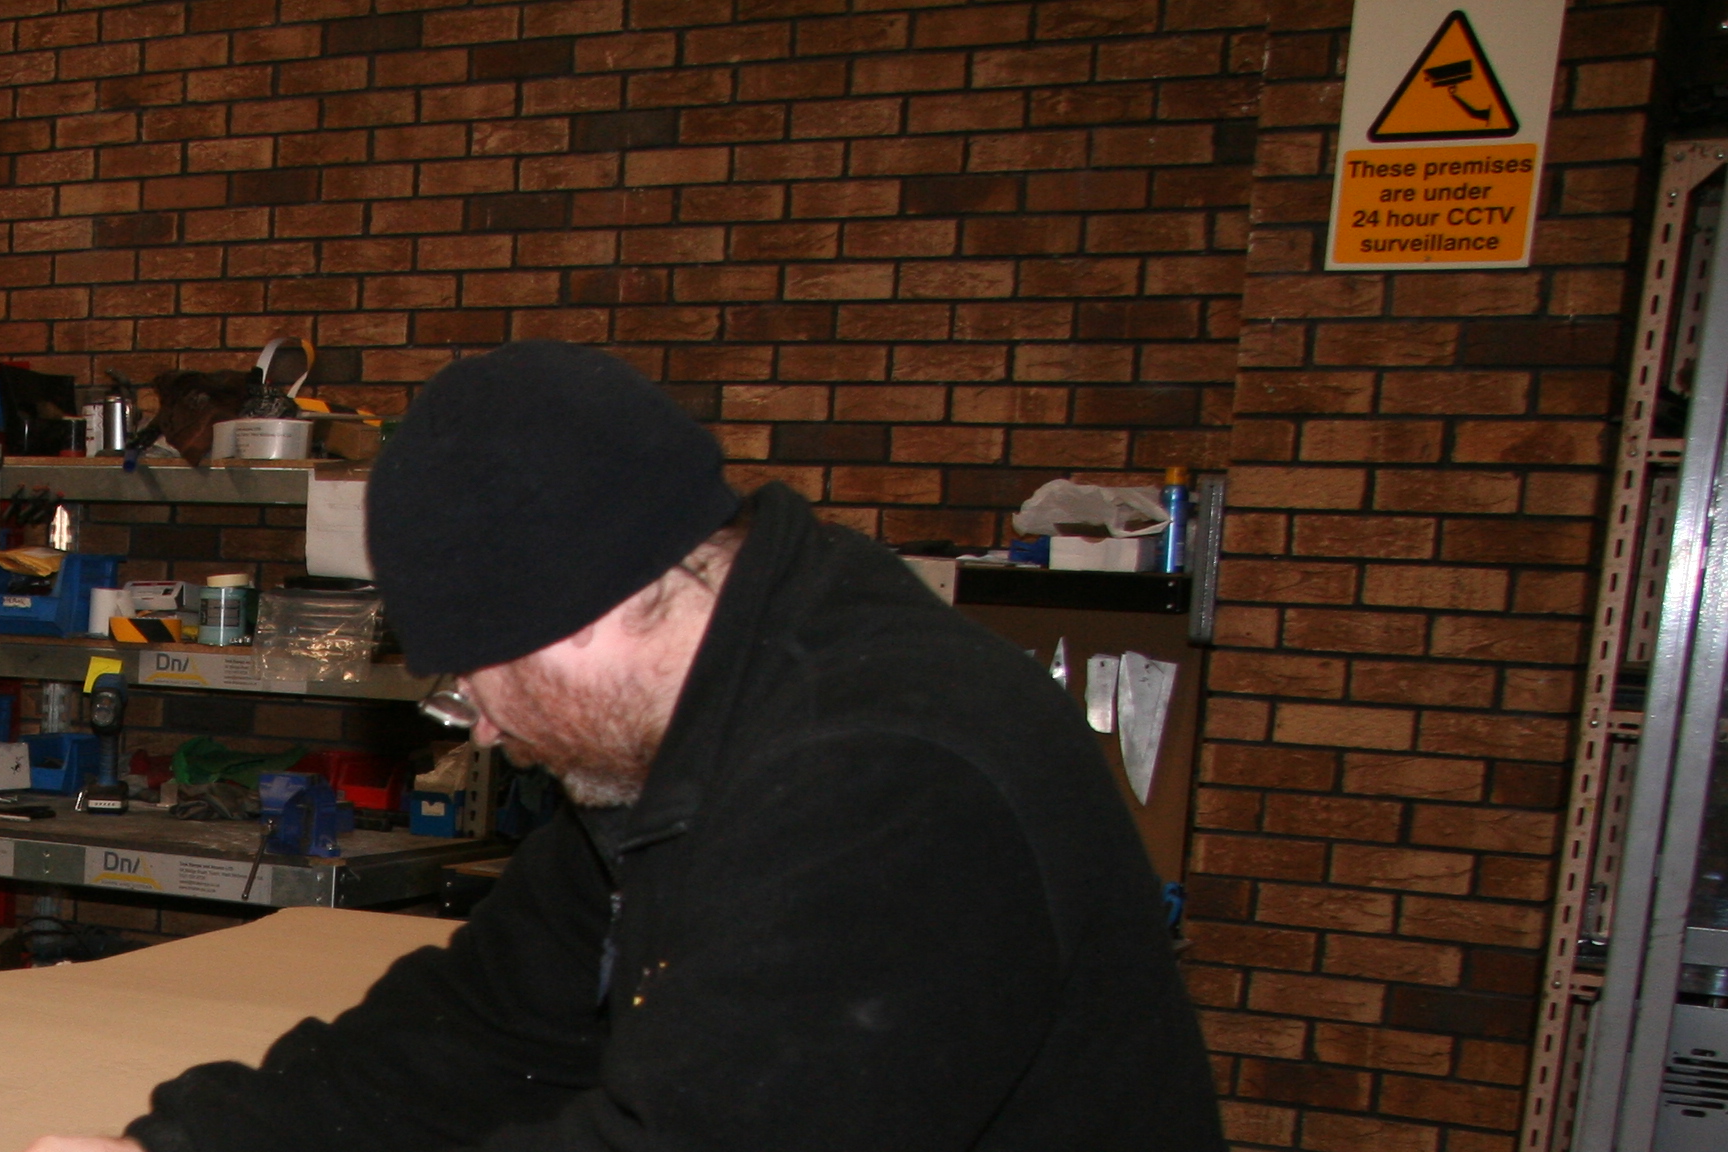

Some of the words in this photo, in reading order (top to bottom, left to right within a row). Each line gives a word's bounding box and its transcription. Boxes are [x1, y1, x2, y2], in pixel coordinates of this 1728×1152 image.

[1348, 160, 1416, 179] These
[1424, 157, 1532, 181] premises
[1379, 186, 1415, 203] are
[1424, 183, 1491, 202] under
[1352, 210, 1379, 228] 24
[1386, 209, 1439, 228] hour
[1446, 206, 1515, 226] CCTV
[1360, 233, 1499, 253] surveillance
